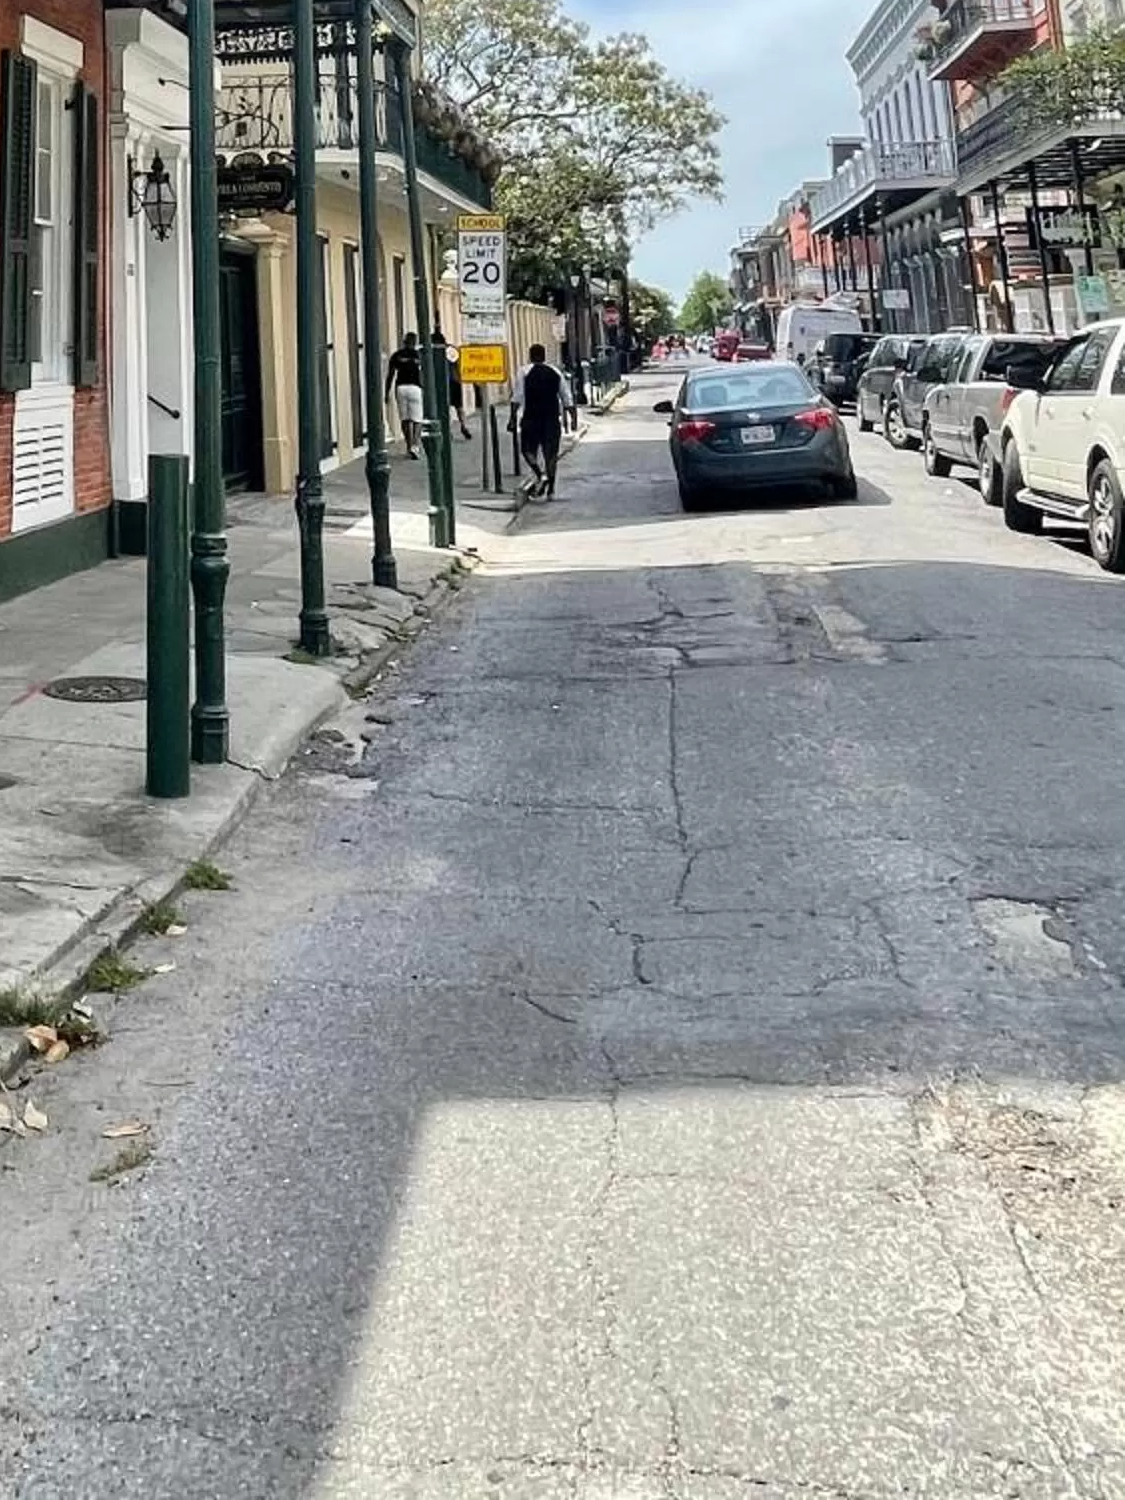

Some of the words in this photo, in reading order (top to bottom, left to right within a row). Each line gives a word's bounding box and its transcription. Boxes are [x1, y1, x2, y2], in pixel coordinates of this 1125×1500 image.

[461, 218, 501, 229] SCHOOL
[462, 235, 501, 247] SPEED
[465, 247, 496, 259] LIMIT
[462, 261, 500, 284] 20
